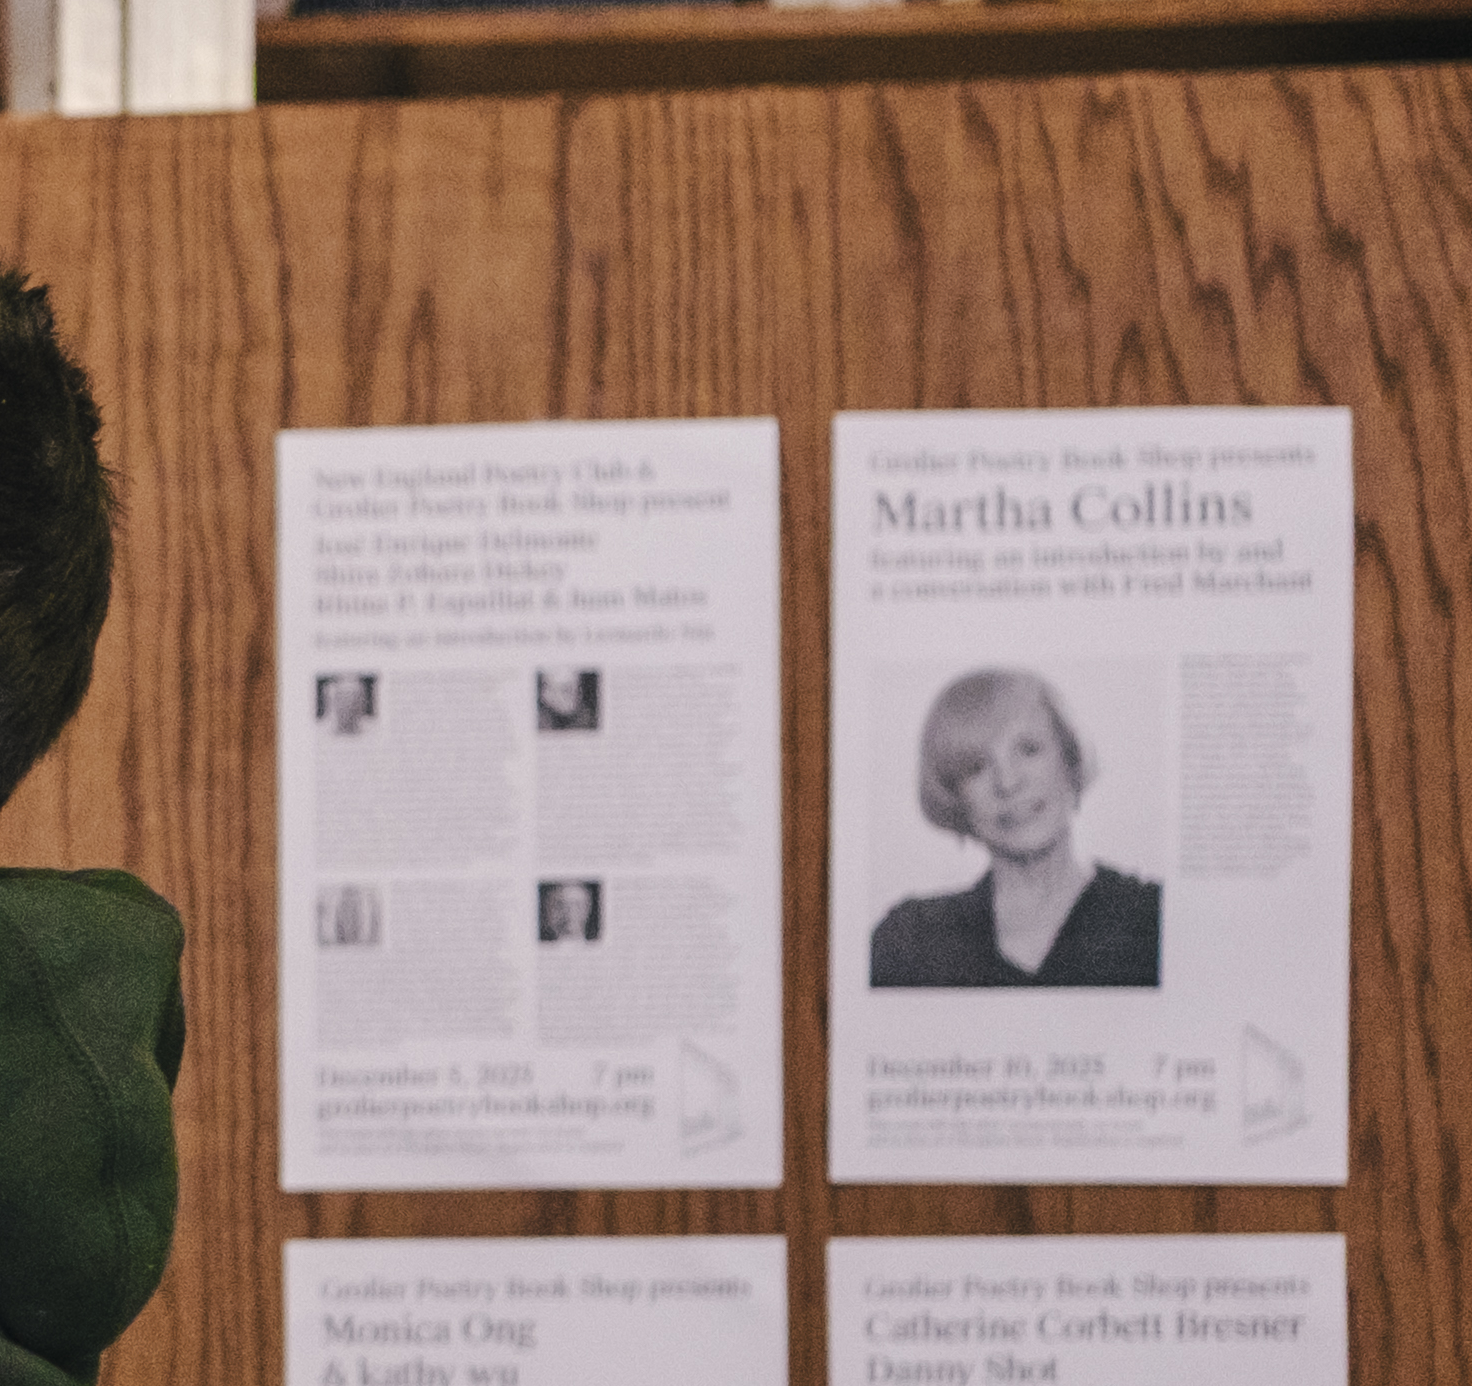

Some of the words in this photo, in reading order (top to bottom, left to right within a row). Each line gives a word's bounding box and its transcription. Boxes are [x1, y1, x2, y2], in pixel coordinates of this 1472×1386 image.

[871, 480, 1054, 536] Martha
[1071, 479, 1254, 533] Collins
[322, 1311, 451, 1348] Monica
[461, 1313, 537, 1354] Ong
[864, 1309, 1024, 1344] Catherine
[983, 1353, 1058, 1386] Shot
